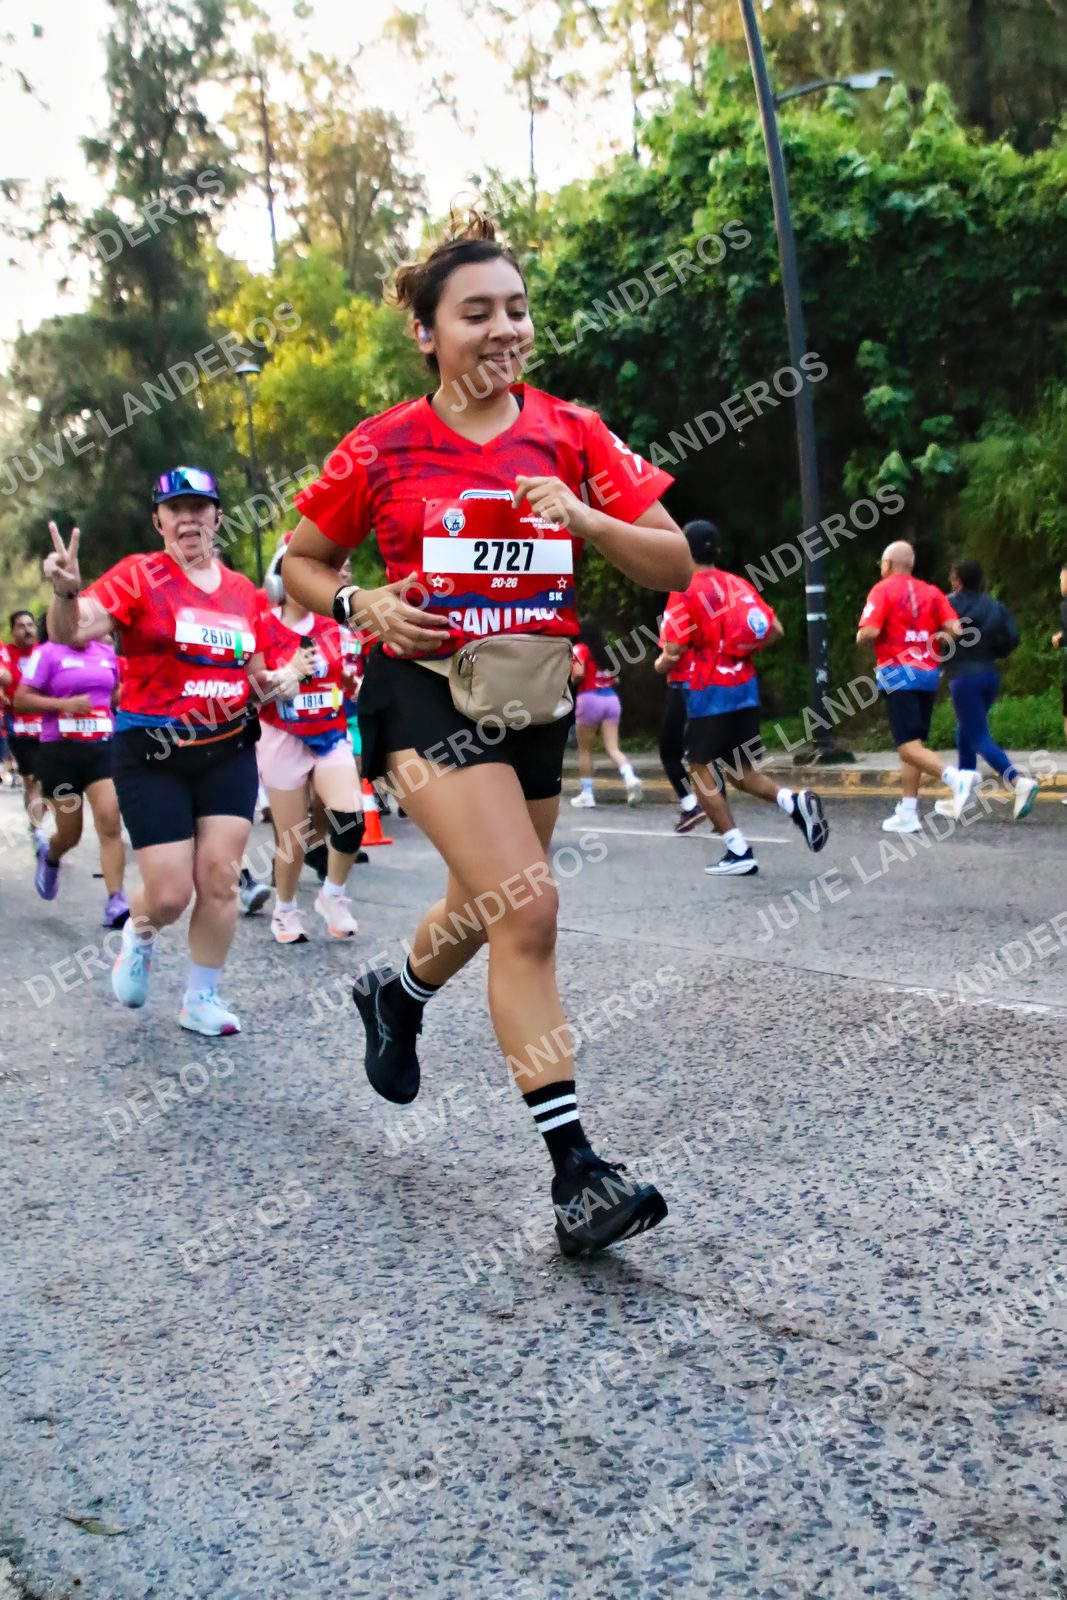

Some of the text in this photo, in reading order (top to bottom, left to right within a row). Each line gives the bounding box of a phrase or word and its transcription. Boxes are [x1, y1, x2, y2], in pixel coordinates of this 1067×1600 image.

[474, 541, 534, 571] 2727
[202, 628, 232, 647] 2610
[303, 694, 323, 708] 1814
